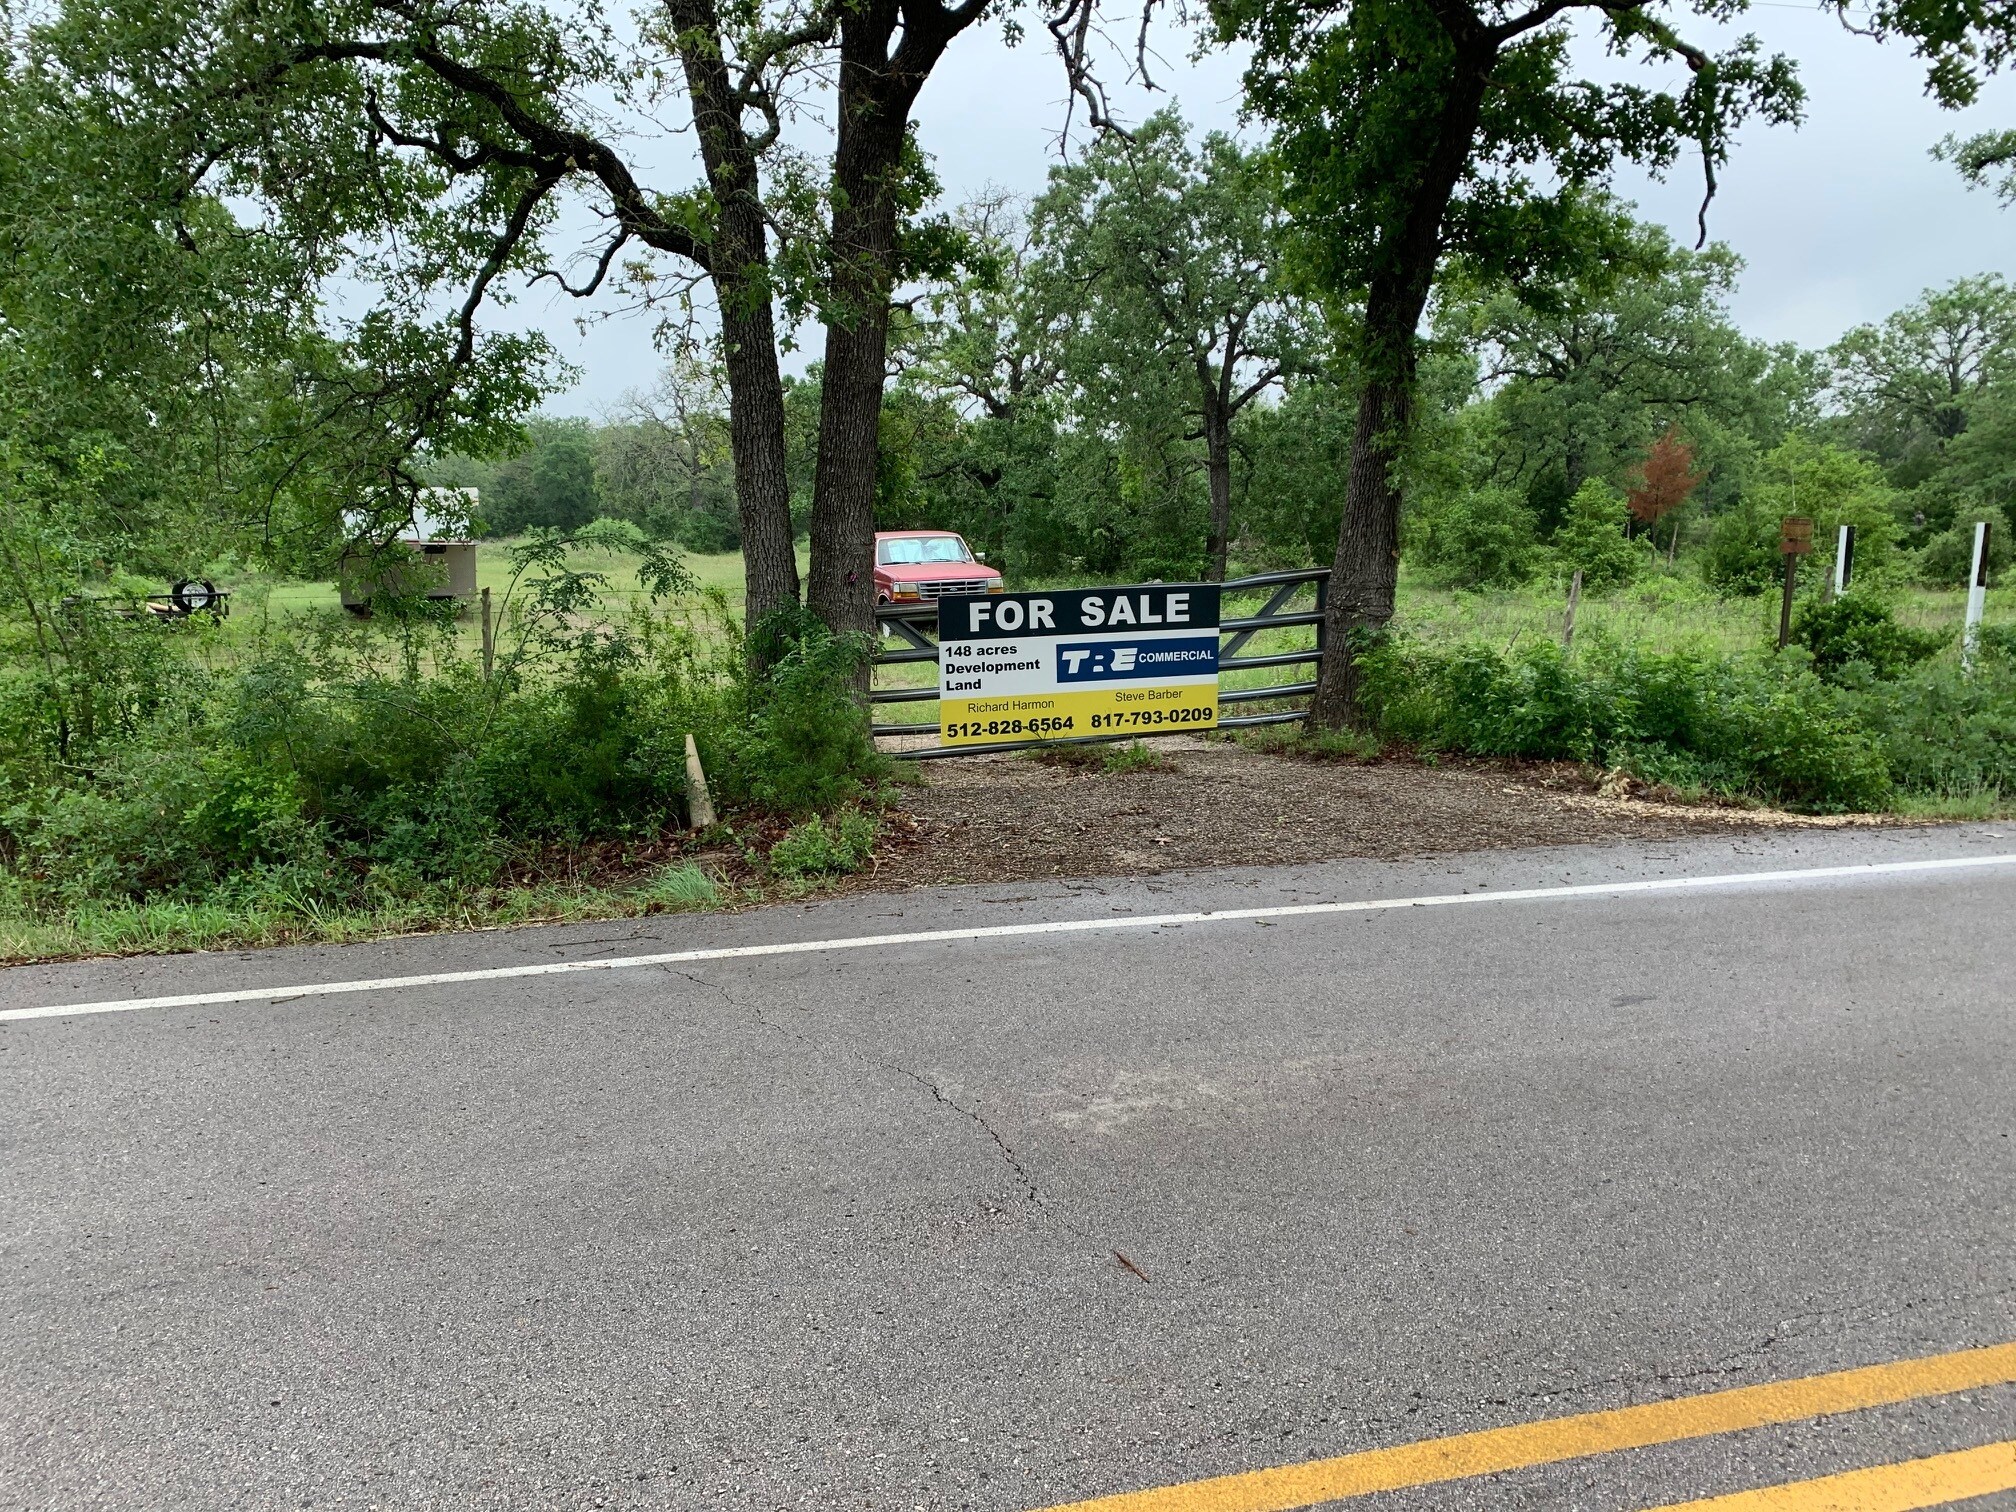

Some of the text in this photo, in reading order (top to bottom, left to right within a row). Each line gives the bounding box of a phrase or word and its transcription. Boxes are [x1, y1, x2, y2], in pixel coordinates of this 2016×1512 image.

[969, 593, 1190, 632] FOR SALE
[945, 644, 1018, 658] 148 acres
[1139, 650, 1214, 663] COMMERCIAL
[945, 659, 1041, 675] Development
[946, 679, 982, 691] Land
[1115, 689, 1183, 702] Steve Barber
[968, 699, 1055, 713] Richard Harmon
[1091, 707, 1213, 728] 817-793-0209
[947, 716, 1074, 738] 512-828-6564
